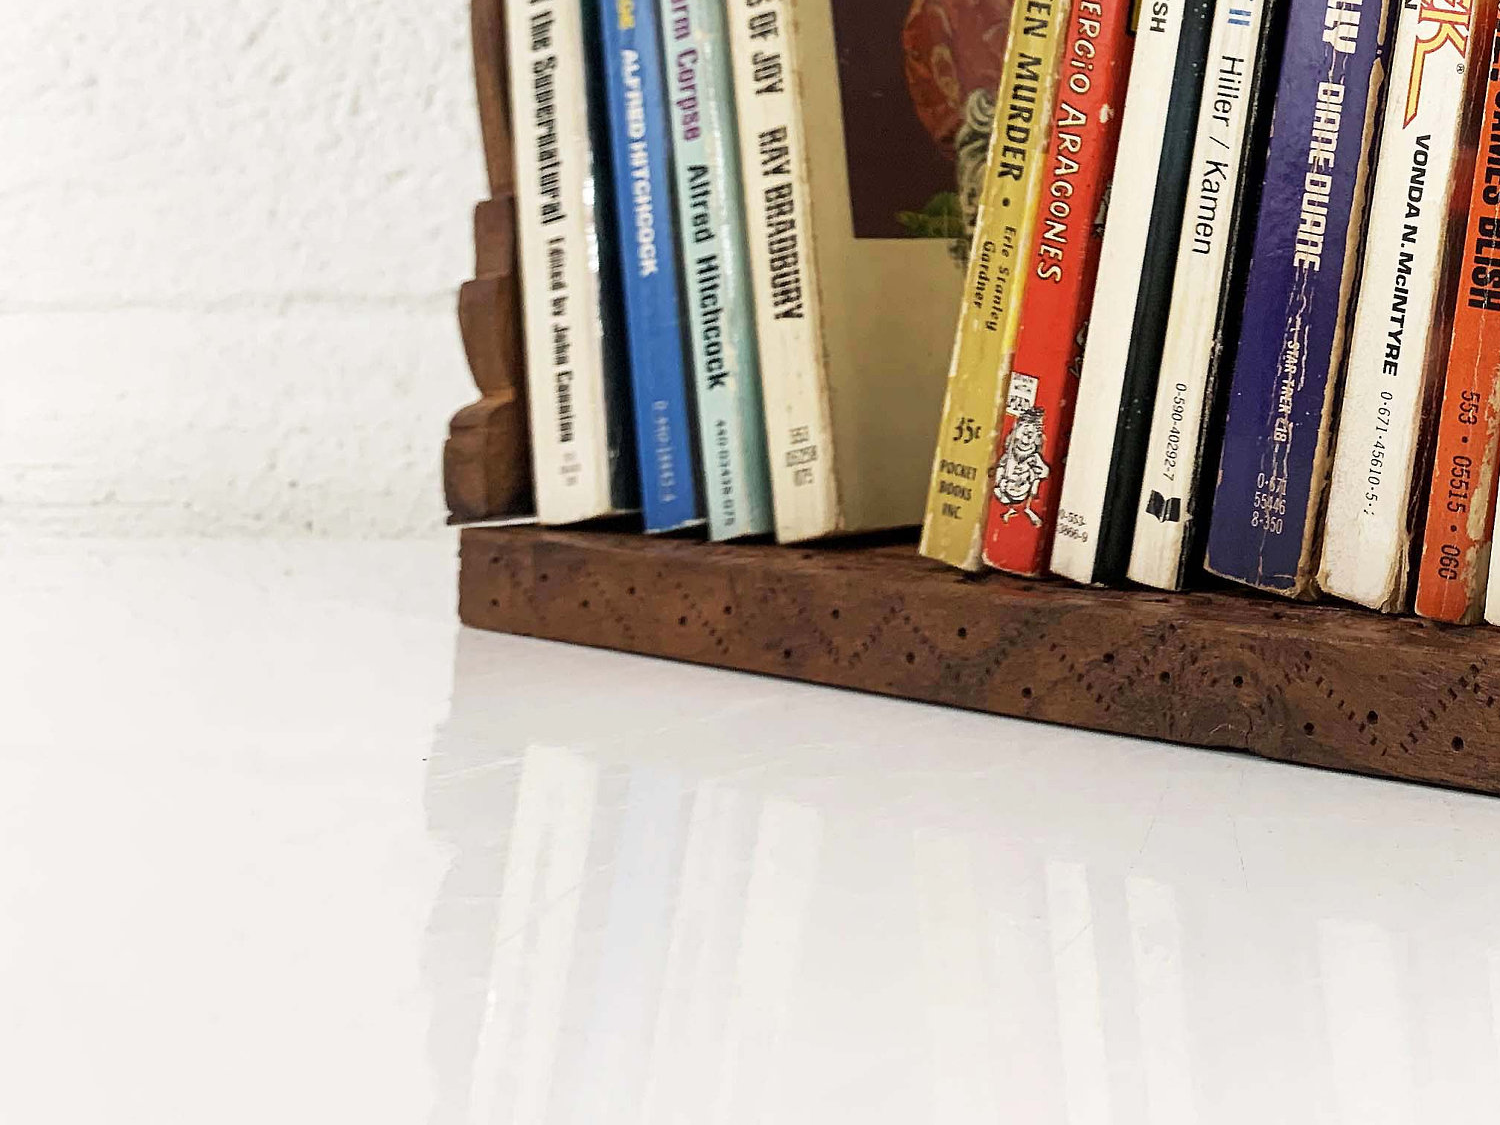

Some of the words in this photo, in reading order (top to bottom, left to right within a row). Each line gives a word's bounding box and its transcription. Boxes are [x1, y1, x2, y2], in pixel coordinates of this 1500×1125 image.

[529, 10, 556, 52] the
[748, 11, 780, 42] OF
[1227, 8, 1253, 27] II
[619, 48, 647, 140] ALFRED
[675, 48, 701, 142] Corpse
[752, 52, 784, 96] JOY
[1213, 55, 1245, 127] Hiller
[533, 55, 567, 226] Supernatural
[758, 125, 791, 177] RAY
[997, 52, 1042, 182] MURDER
[1308, 82, 1345, 168] DIANE
[628, 140, 660, 278] HITCHCOCK
[688, 162, 715, 244] Alfred
[1036, 101, 1088, 284] ARAGONES
[1192, 159, 1229, 255] Kamen
[1405, 134, 1431, 219] VONDA
[765, 182, 805, 321] BRADBURY
[1000, 225, 1018, 259] Erle
[1293, 172, 1332, 271] DUANE
[1400, 224, 1418, 248] N.
[551, 295, 569, 318] by
[973, 240, 996, 309] Gardner
[986, 263, 1010, 332] Stanley
[552, 322, 571, 366] John
[697, 254, 729, 391] Hitchcock
[1382, 252, 1414, 377] McINTYRE
[1283, 341, 1301, 375] STAR
[1277, 377, 1295, 414] TREK
[1459, 390, 1481, 426] 553
[1162, 383, 1188, 481] 0-590-40292-7
[938, 480, 972, 501] BOOKS
[940, 458, 978, 481] POCKET
[1446, 454, 1472, 514] 05515
[942, 504, 962, 520] INC.
[1438, 543, 1461, 581] 060
